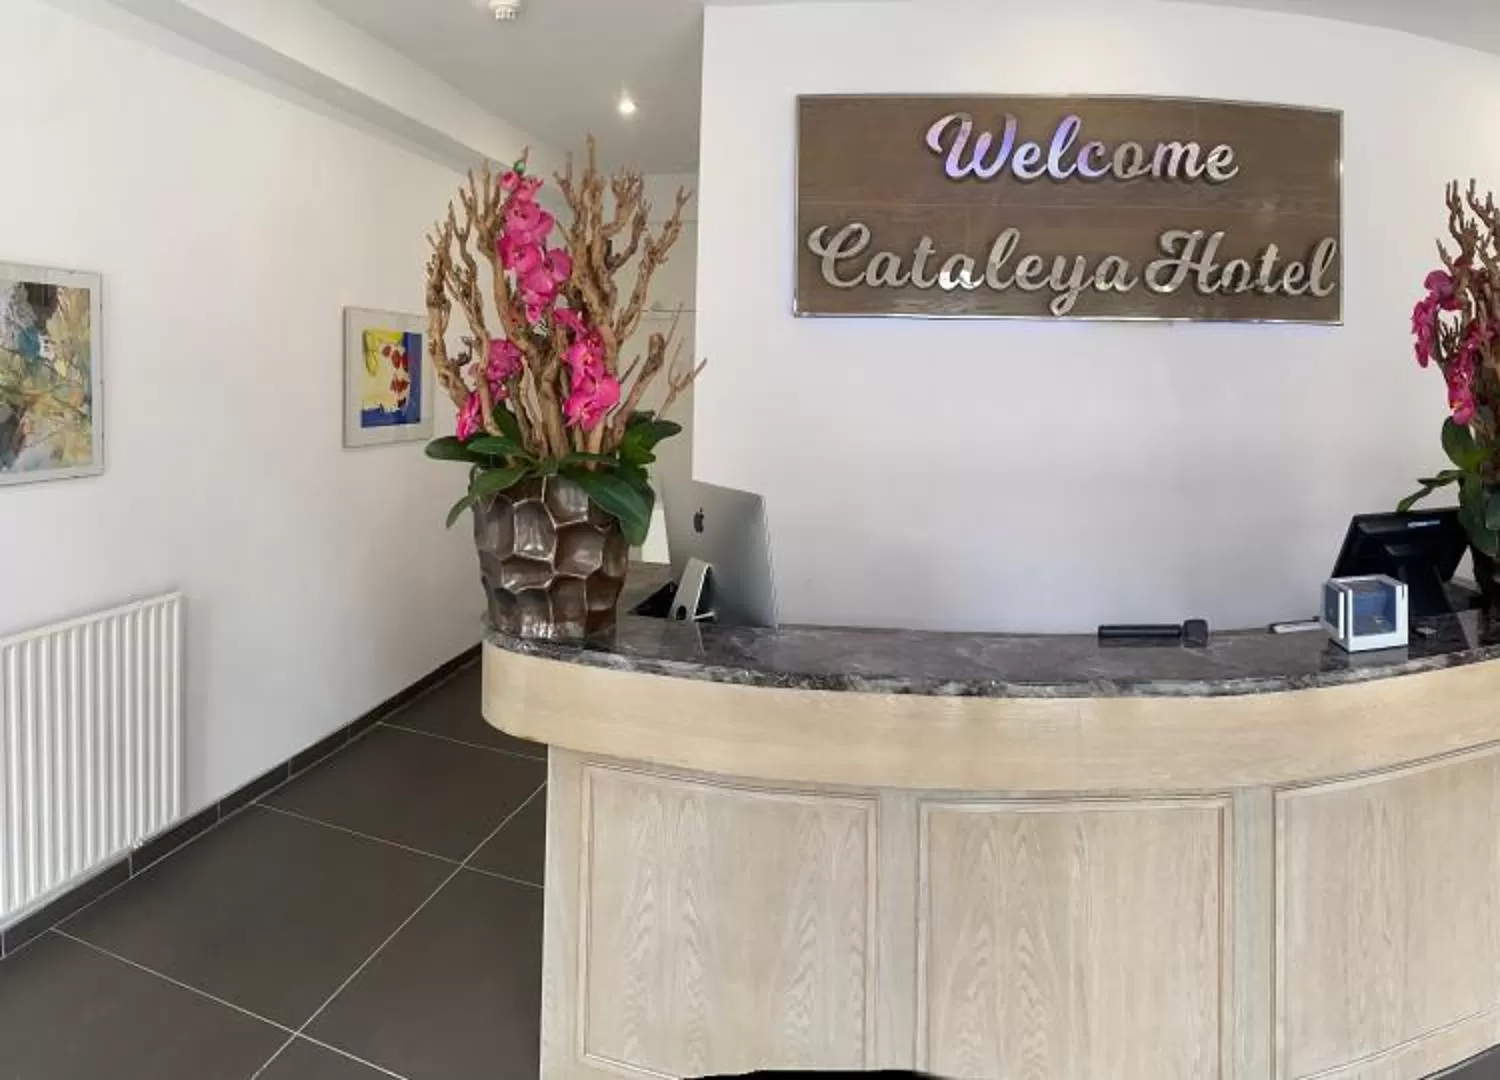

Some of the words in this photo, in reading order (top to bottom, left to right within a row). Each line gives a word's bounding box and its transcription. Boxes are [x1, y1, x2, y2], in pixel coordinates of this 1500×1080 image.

[925, 111, 1241, 182] Welcome
[807, 222, 1140, 317] Cataleya
[1143, 229, 1338, 297] Hotel
